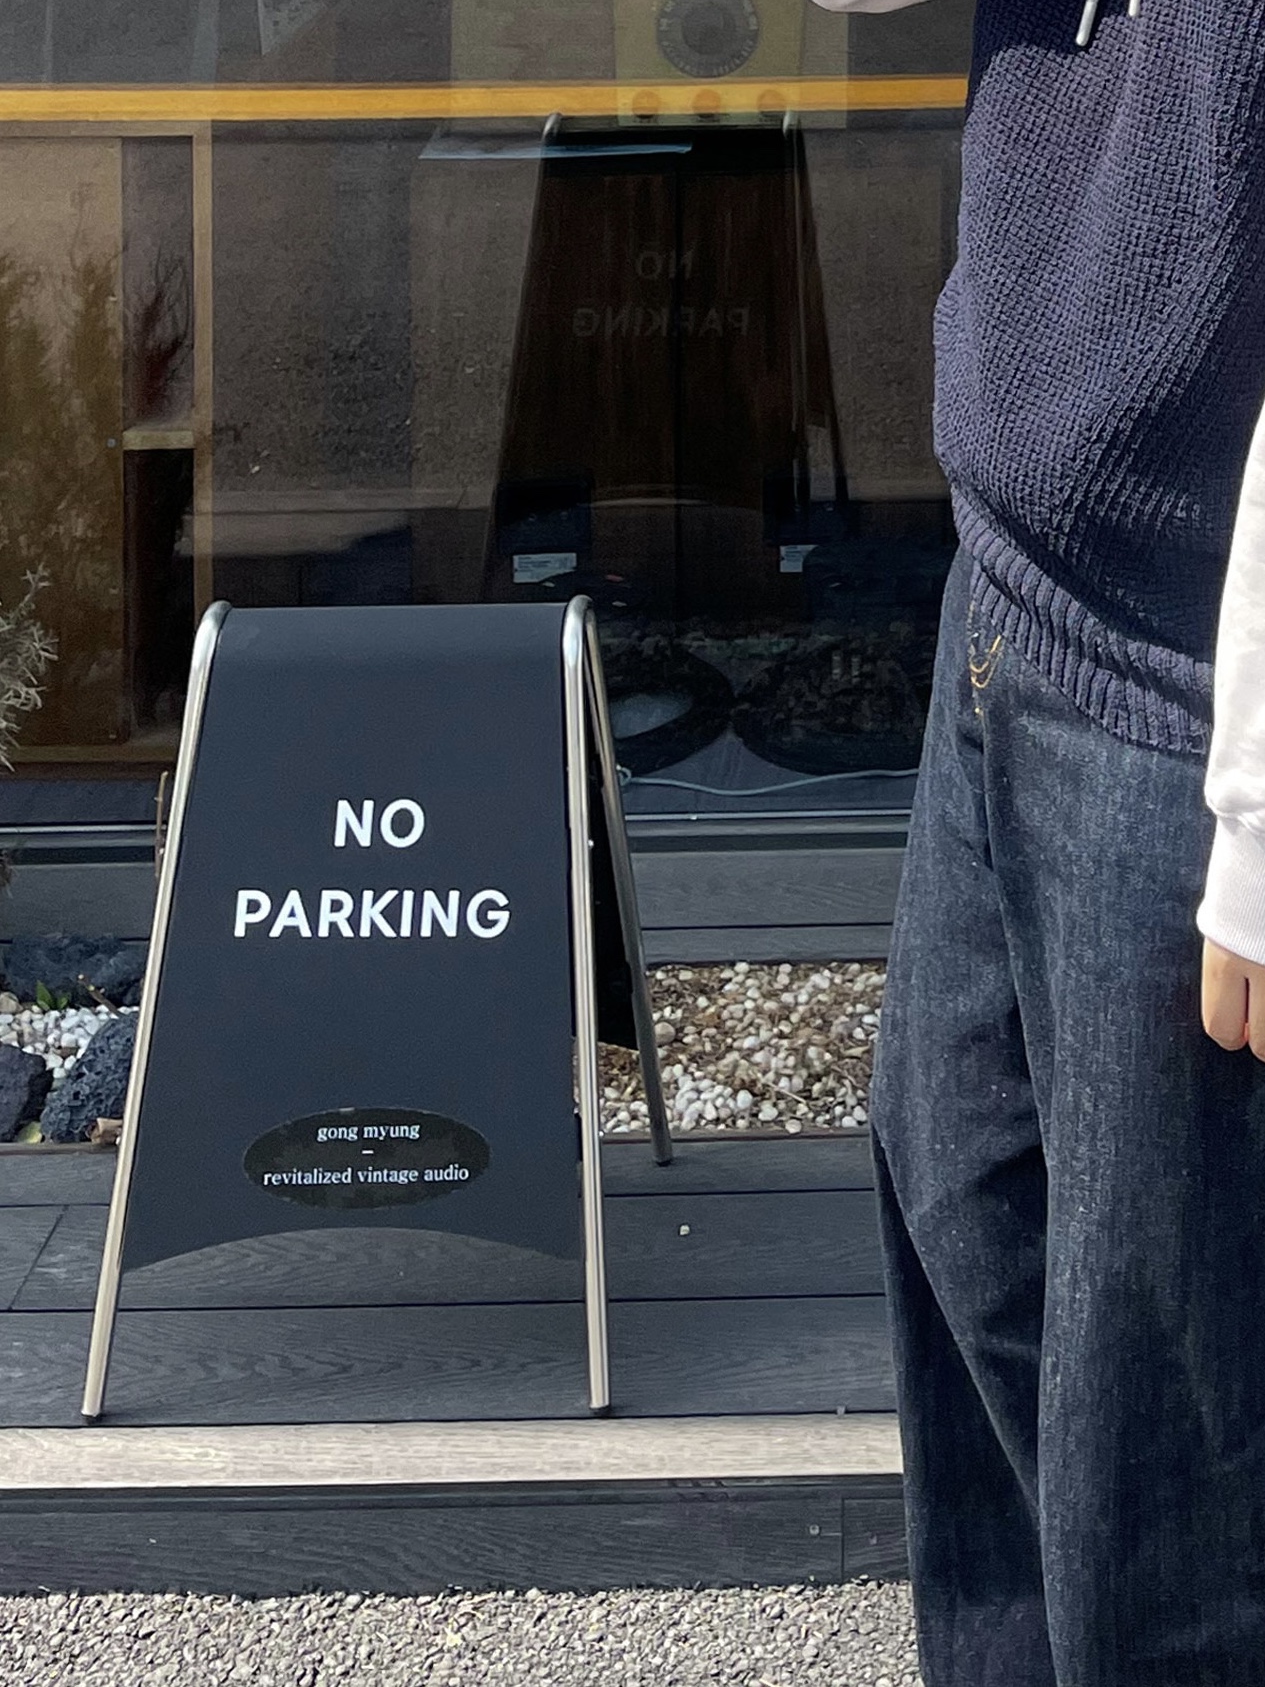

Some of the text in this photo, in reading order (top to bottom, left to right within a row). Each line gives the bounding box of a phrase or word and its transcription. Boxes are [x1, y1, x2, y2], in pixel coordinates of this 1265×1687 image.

[333, 798, 425, 849] NO
[233, 889, 511, 939] PARKING
[316, 1124, 421, 1142] gong myung
[263, 1163, 470, 1186] revitalized vintage audio
